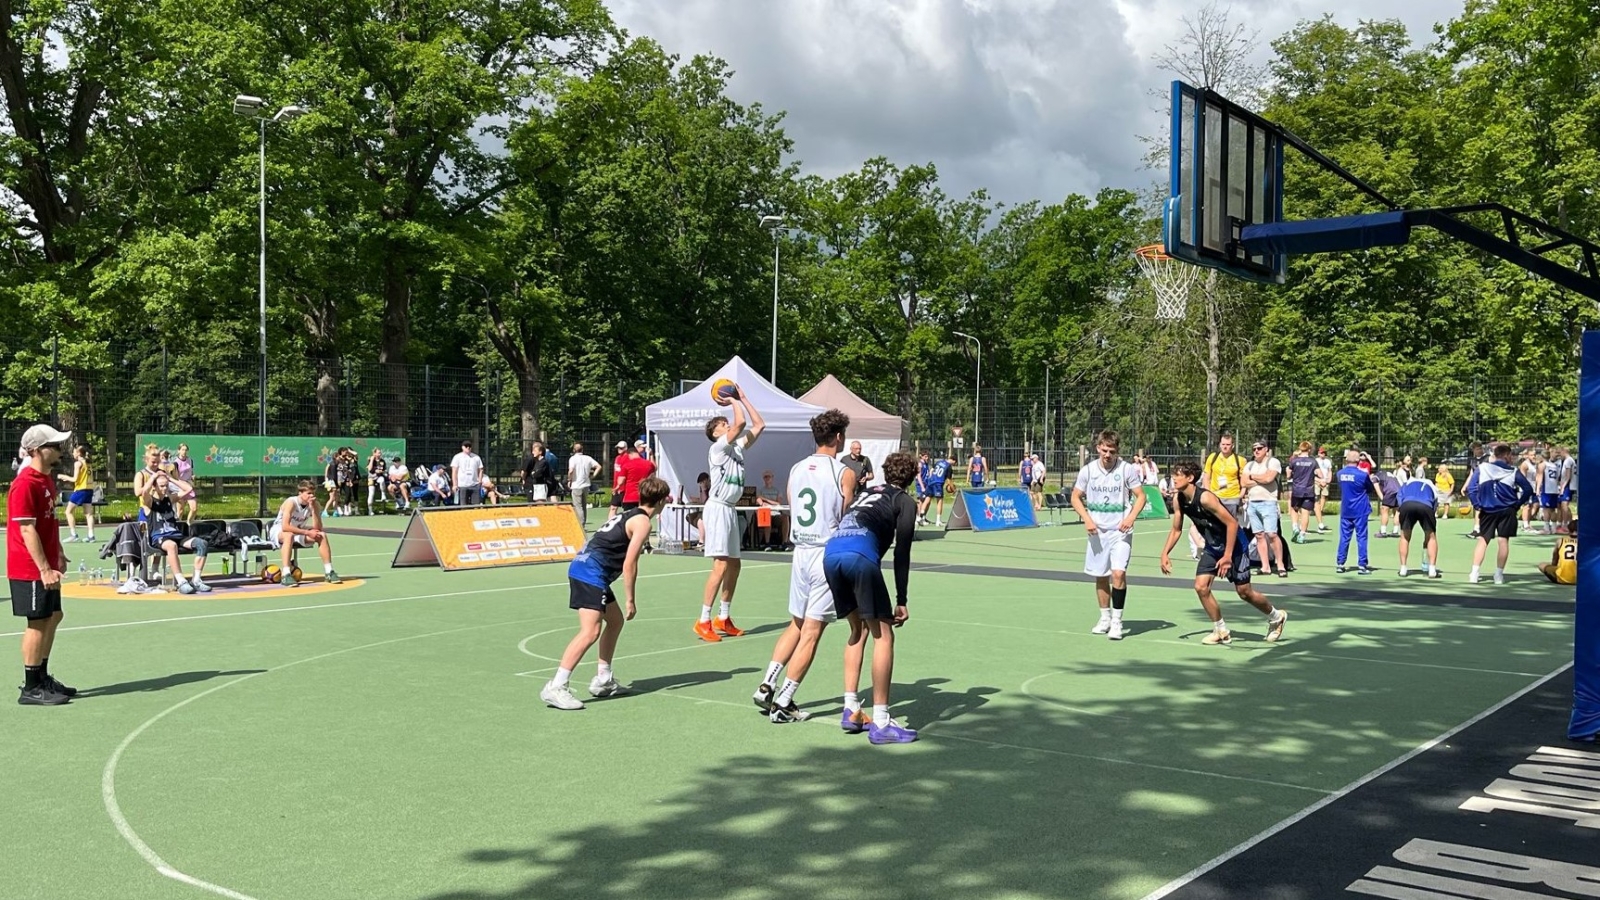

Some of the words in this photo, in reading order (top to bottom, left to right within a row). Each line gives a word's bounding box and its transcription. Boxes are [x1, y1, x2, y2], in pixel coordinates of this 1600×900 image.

[661, 409, 722, 418] VALMIERAS
[661, 419, 704, 427] NOVADS
[223, 456, 244, 464] 2026
[280, 456, 299, 464] 2026
[933, 465, 944, 477] 30
[1091, 485, 1122, 493] MĀRUPE
[850, 492, 882, 508] 12
[1104, 496, 1110, 505] 2
[797, 487, 817, 527] 3
